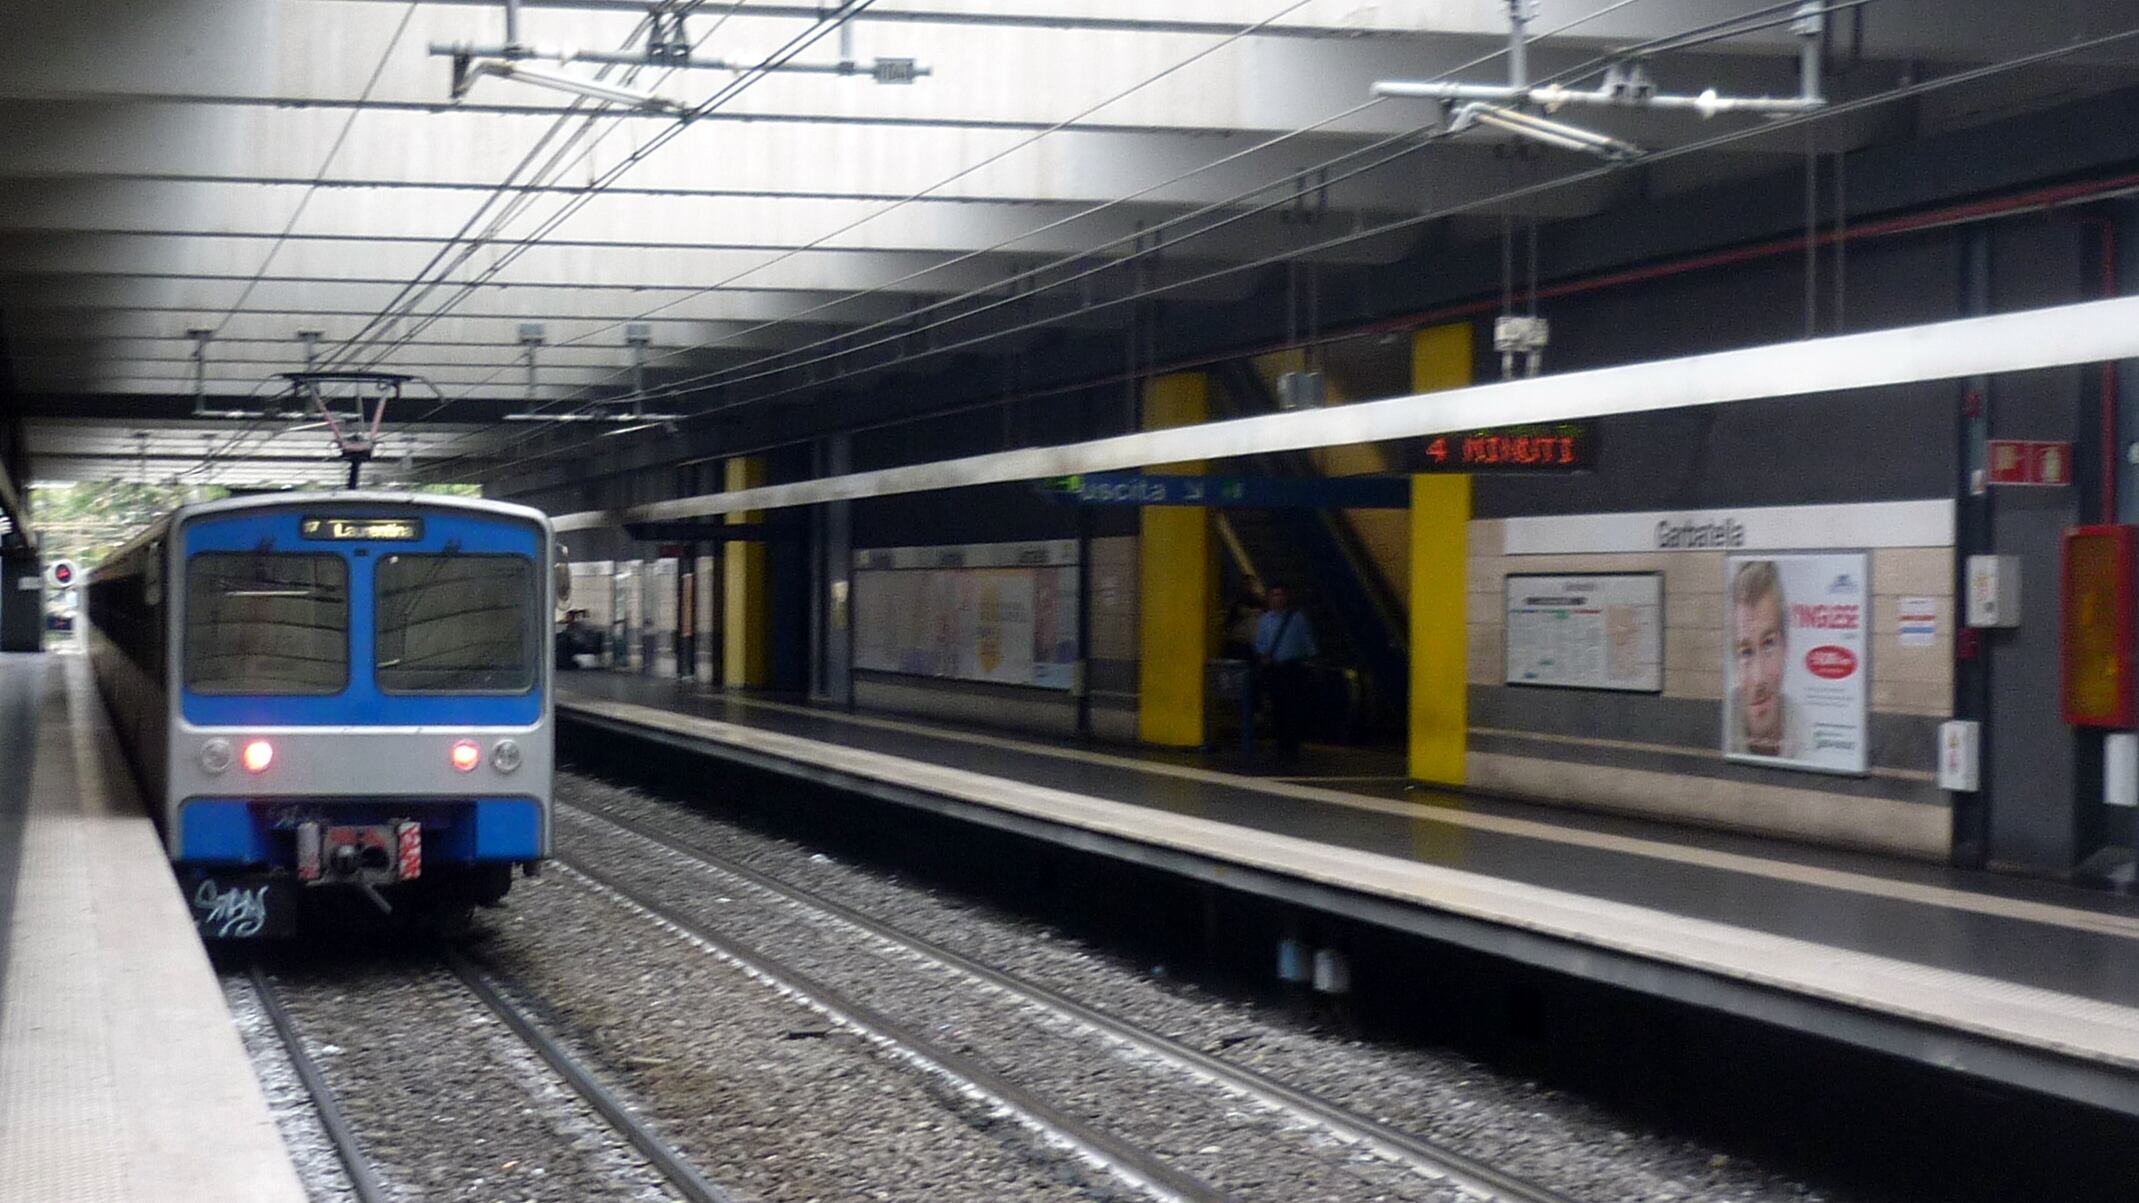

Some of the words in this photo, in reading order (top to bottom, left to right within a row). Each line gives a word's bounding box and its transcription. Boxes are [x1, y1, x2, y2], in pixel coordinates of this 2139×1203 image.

[1426, 435, 1448, 464] 4
[1462, 434, 1576, 464] MINUTI
[1655, 518, 1744, 548] Garbatella
